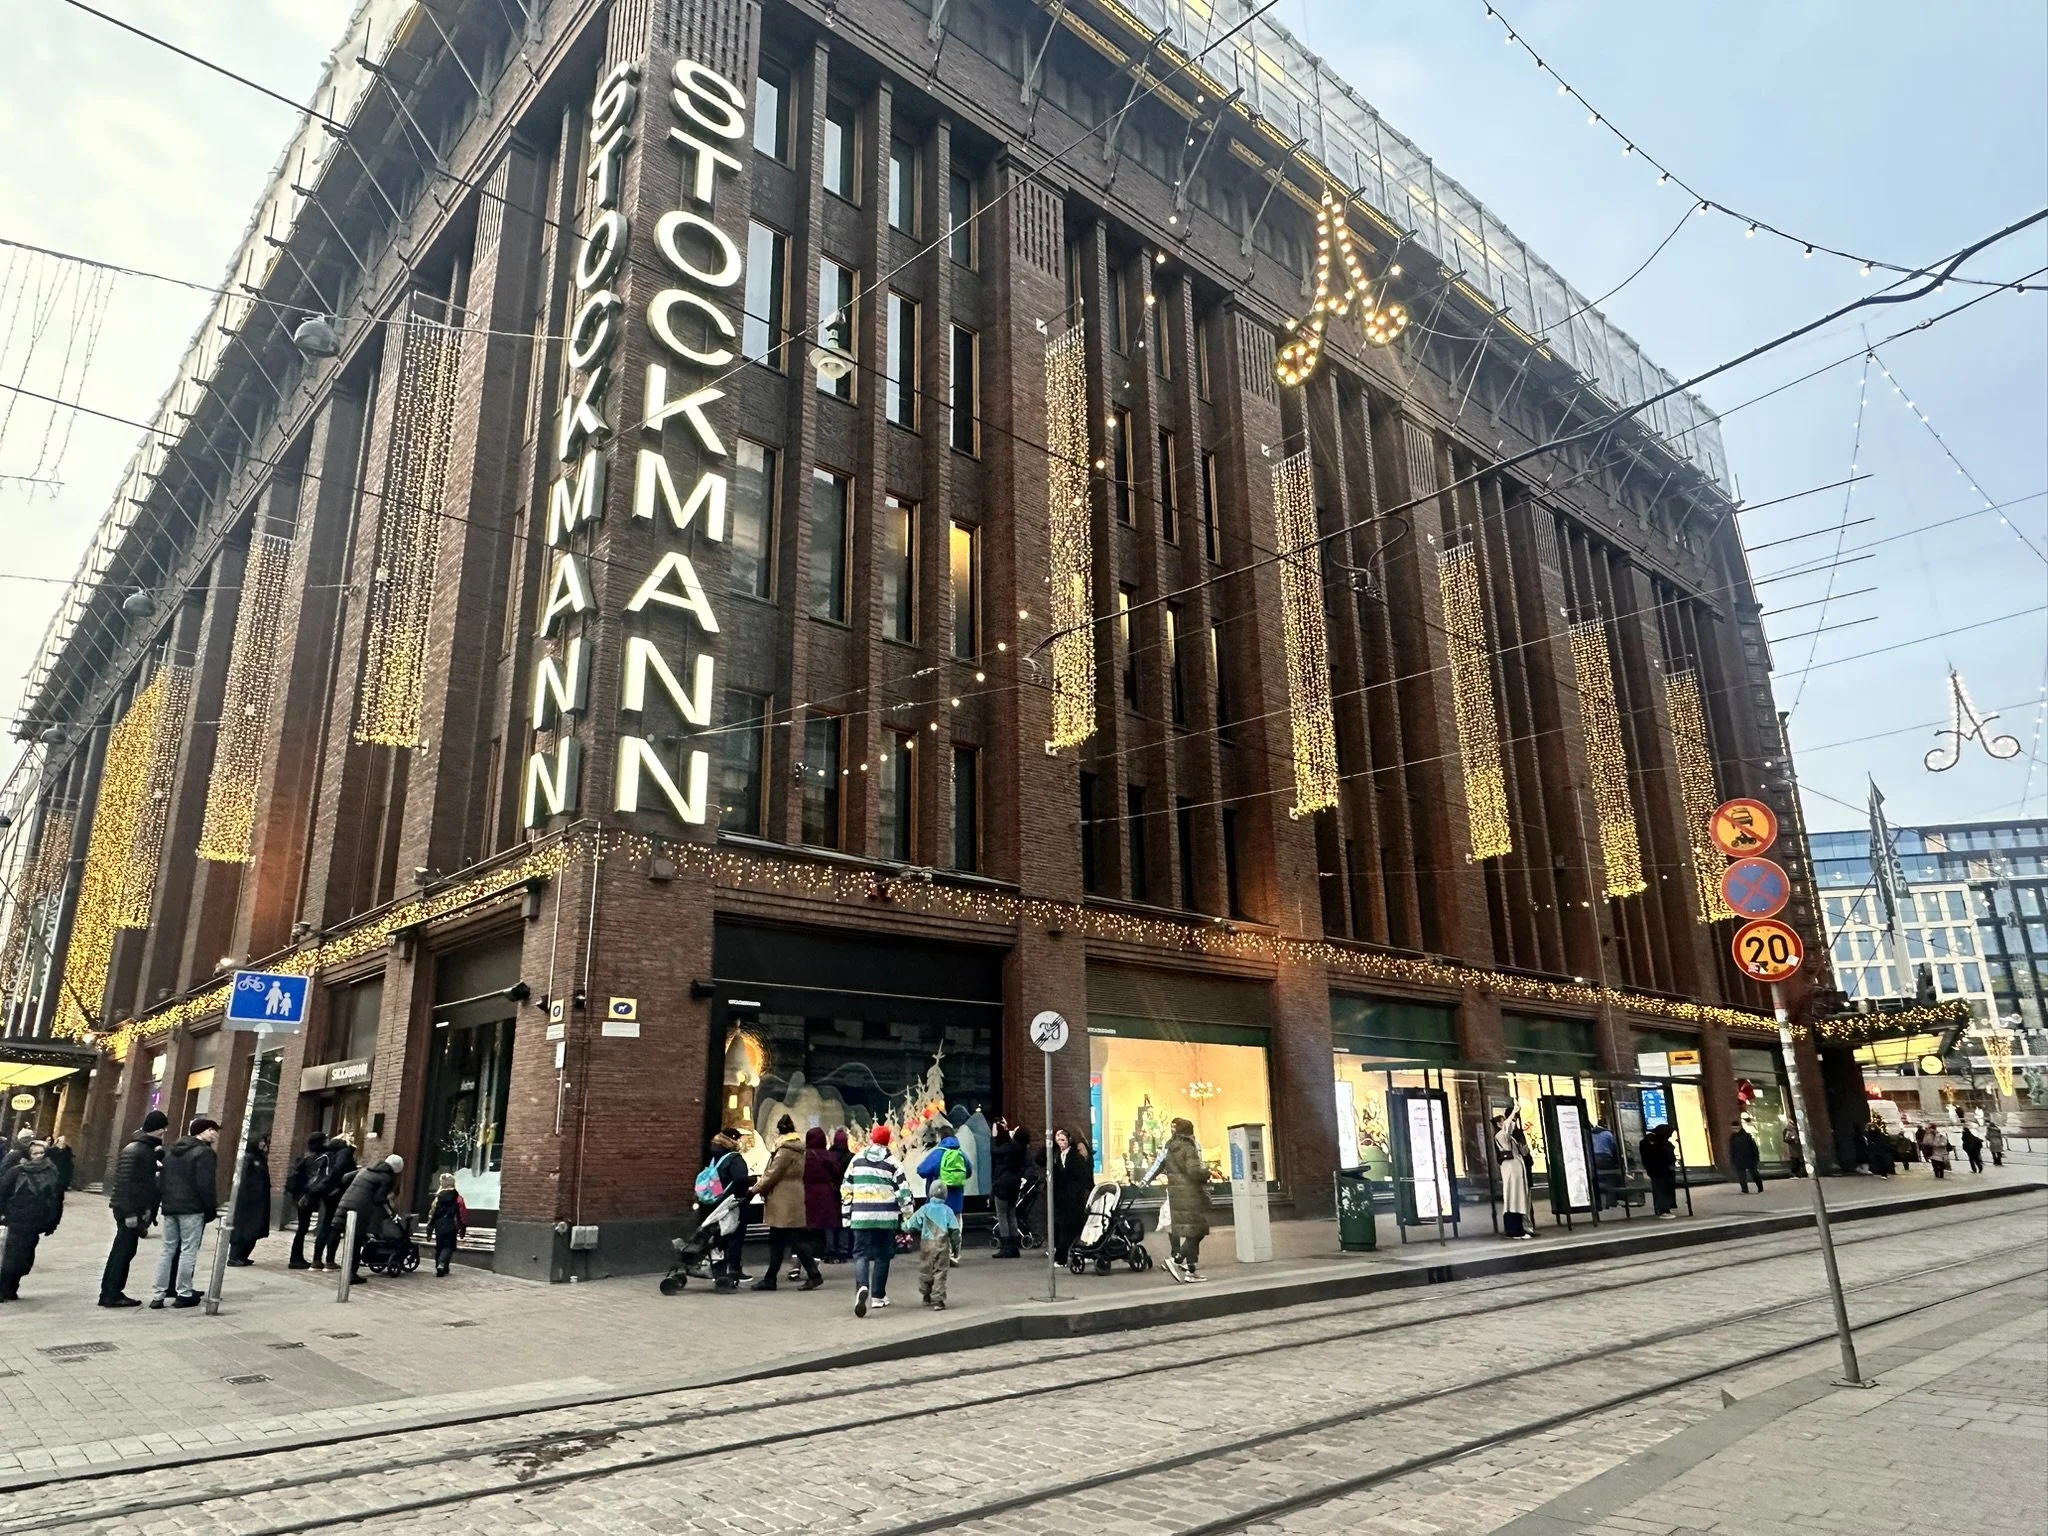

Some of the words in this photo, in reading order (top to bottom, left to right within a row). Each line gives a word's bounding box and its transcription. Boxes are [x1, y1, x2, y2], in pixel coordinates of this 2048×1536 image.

[525, 60, 638, 829] STOCKMANN
[615, 59, 746, 825] STOCKMANN
[1745, 934, 1789, 967] 20
